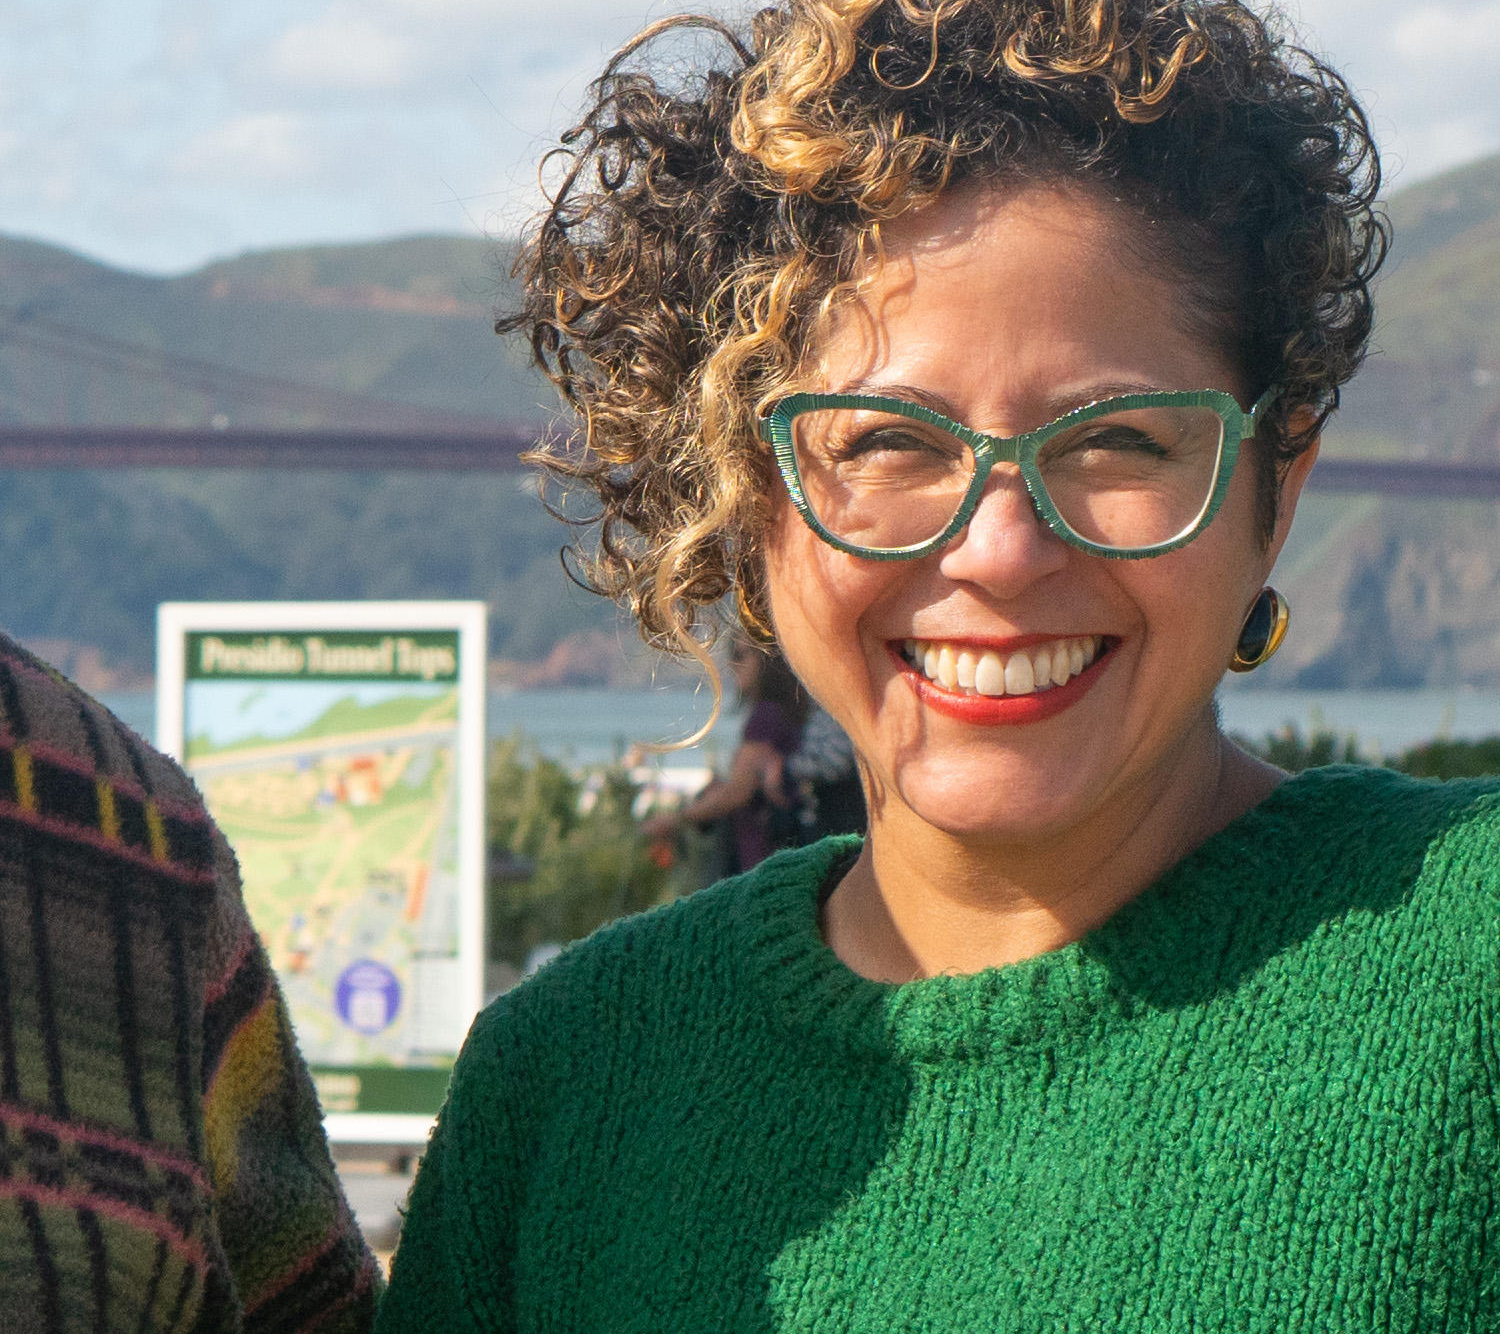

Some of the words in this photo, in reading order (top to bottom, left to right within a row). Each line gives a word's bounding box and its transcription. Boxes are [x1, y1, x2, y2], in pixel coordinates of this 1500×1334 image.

[201, 637, 304, 673] Presidio
[305, 637, 394, 673] Tunnel
[396, 637, 456, 681] Tops
